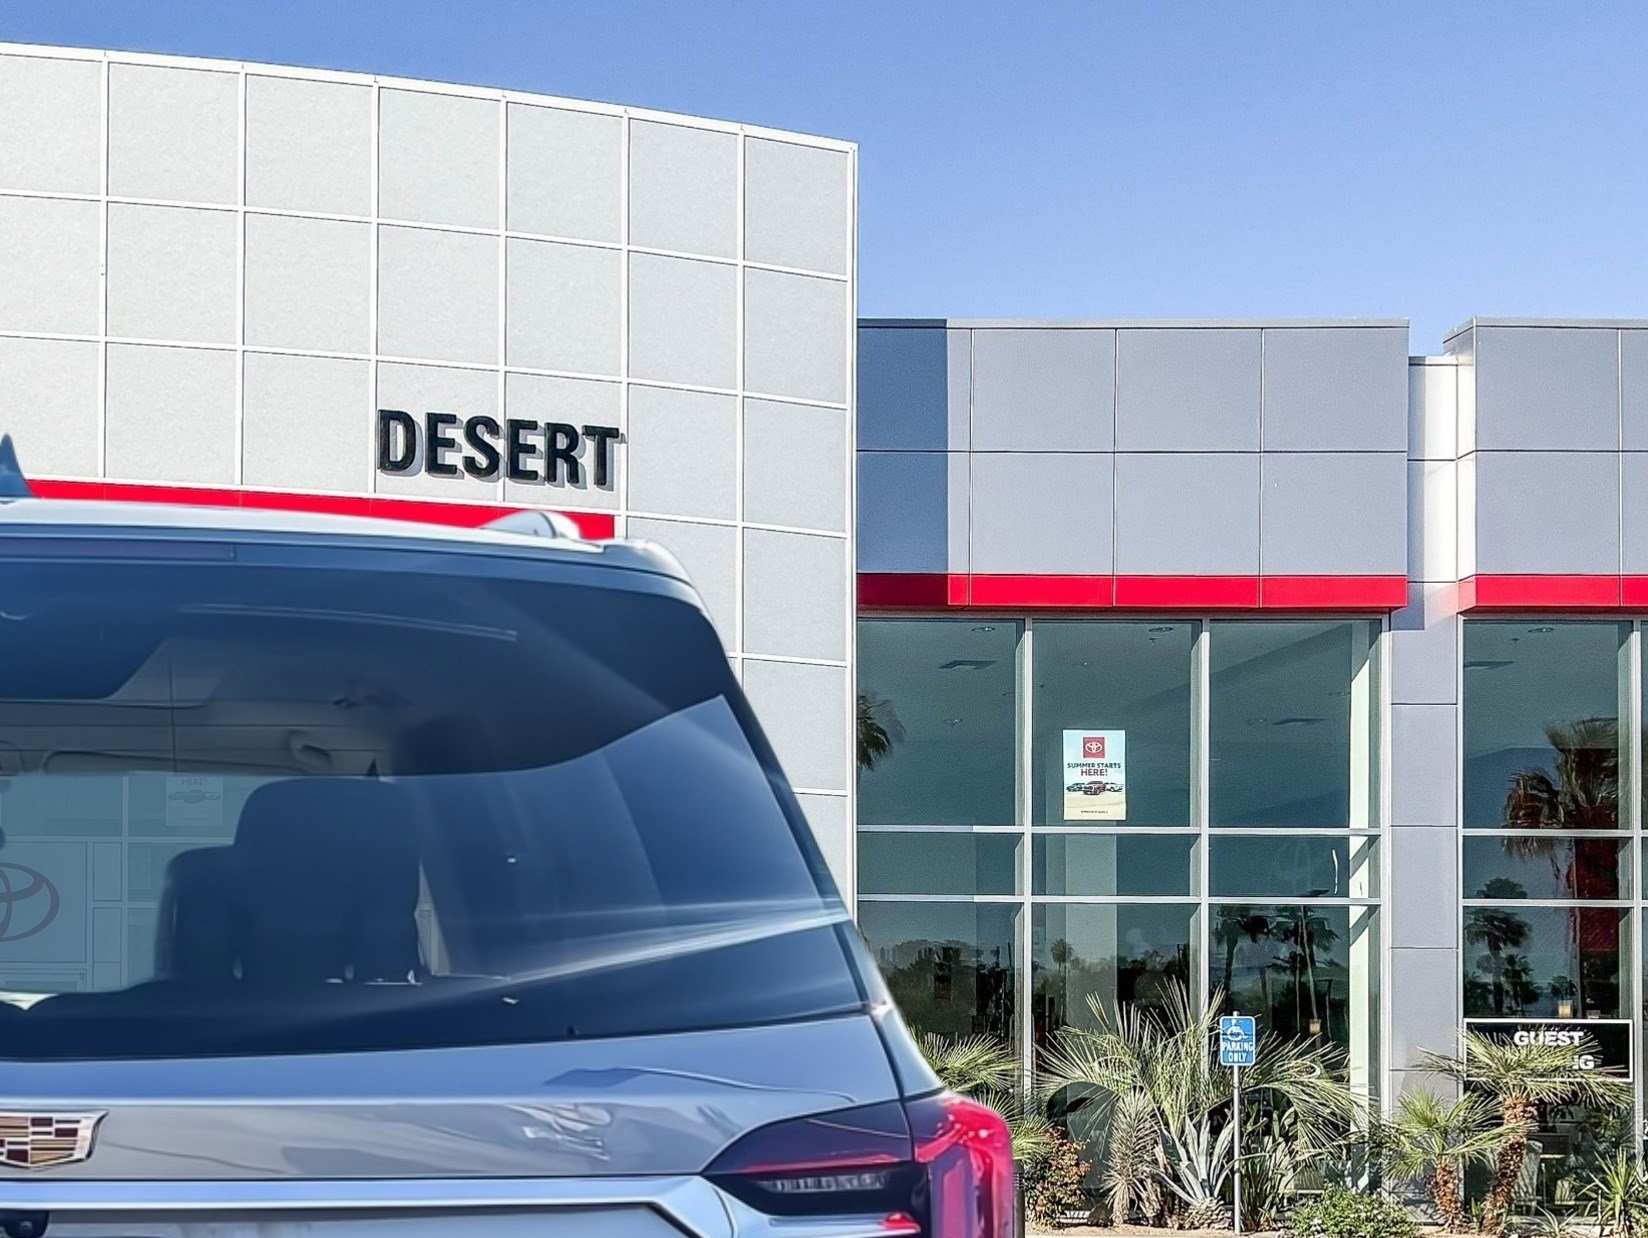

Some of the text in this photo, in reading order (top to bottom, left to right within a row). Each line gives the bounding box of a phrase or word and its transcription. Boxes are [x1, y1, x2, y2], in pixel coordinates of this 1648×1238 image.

[377, 409, 620, 487] DESERT
[1080, 768, 1108, 777] HERE!
[1513, 1030, 1584, 1047] GUEST
[1221, 1041, 1253, 1052] PARKING
[1228, 1051, 1248, 1063] ONLY
